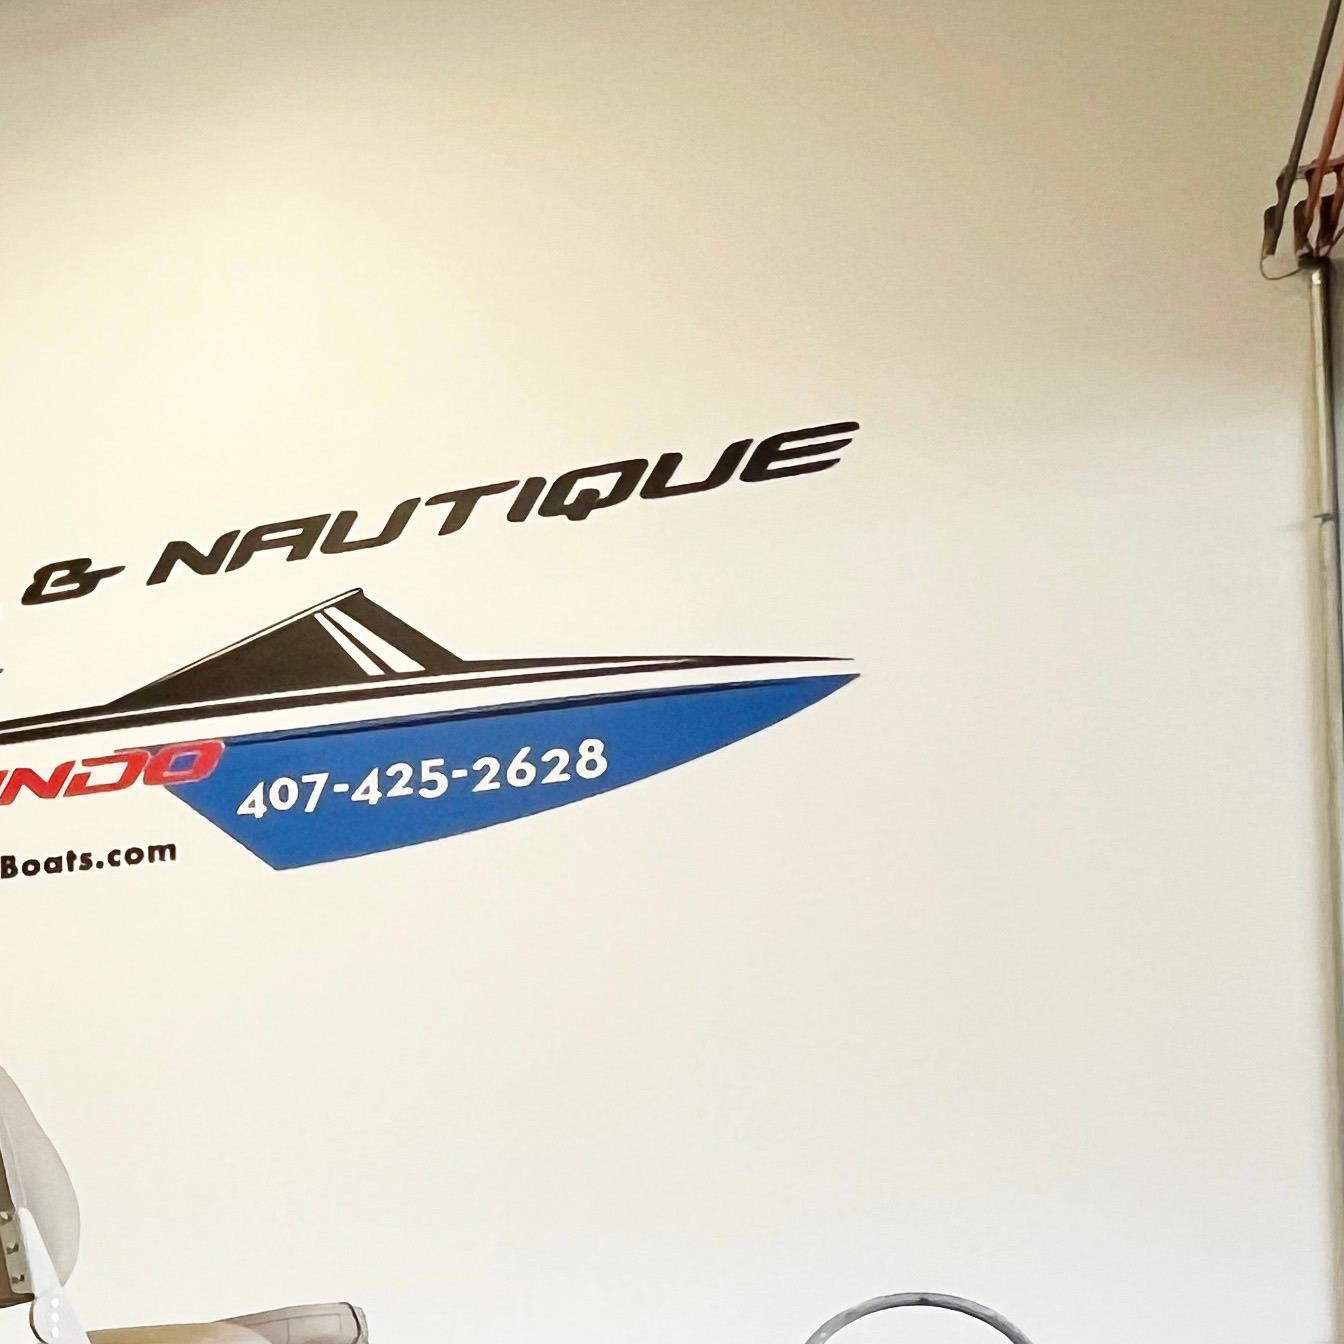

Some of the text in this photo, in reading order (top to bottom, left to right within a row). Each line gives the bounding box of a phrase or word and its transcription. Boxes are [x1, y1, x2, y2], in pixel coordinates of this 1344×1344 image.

[21, 557, 126, 605] &
[146, 421, 860, 586] NAUTIQUE
[236, 738, 609, 818] 407-425-2628
